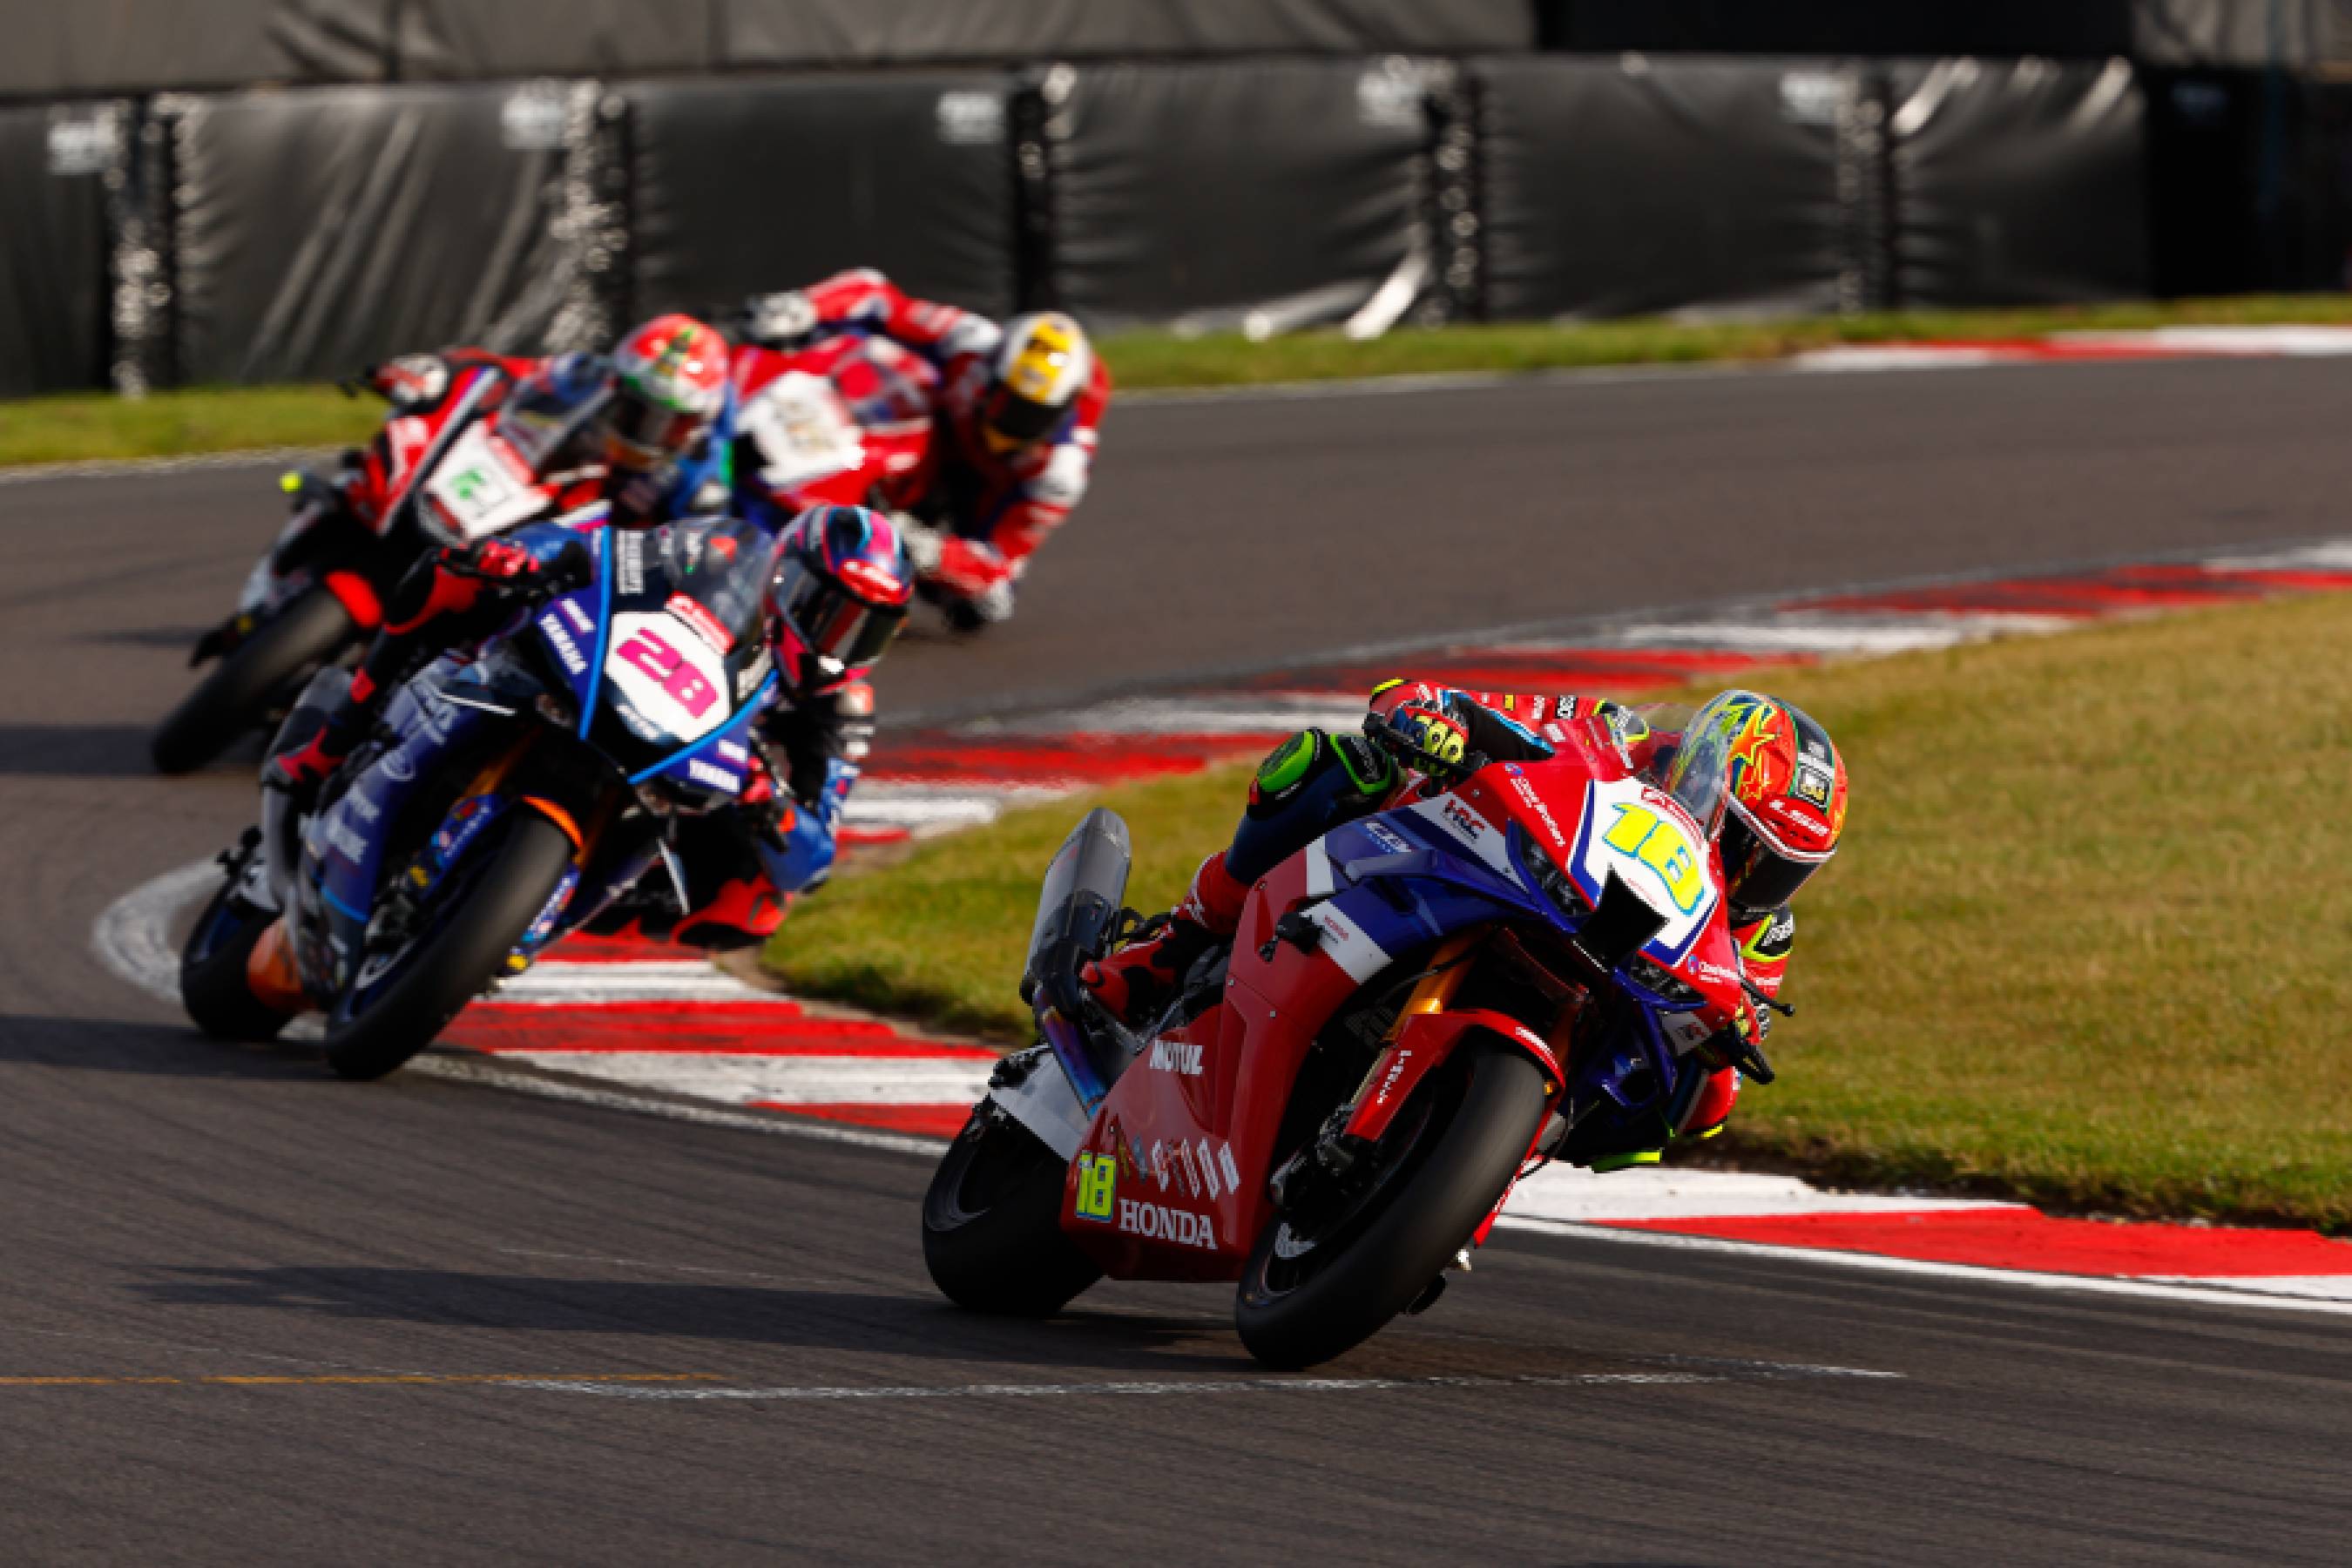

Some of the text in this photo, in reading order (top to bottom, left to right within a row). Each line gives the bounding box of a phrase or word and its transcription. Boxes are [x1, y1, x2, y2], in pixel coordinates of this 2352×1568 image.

[539, 612, 589, 675] YAMAHA
[616, 626, 720, 720] 28
[1602, 801, 1707, 917] 18
[1149, 1039, 1204, 1076] MOTUL
[1076, 1152, 1117, 1223] 18
[1118, 1198, 1219, 1249] HONDA
